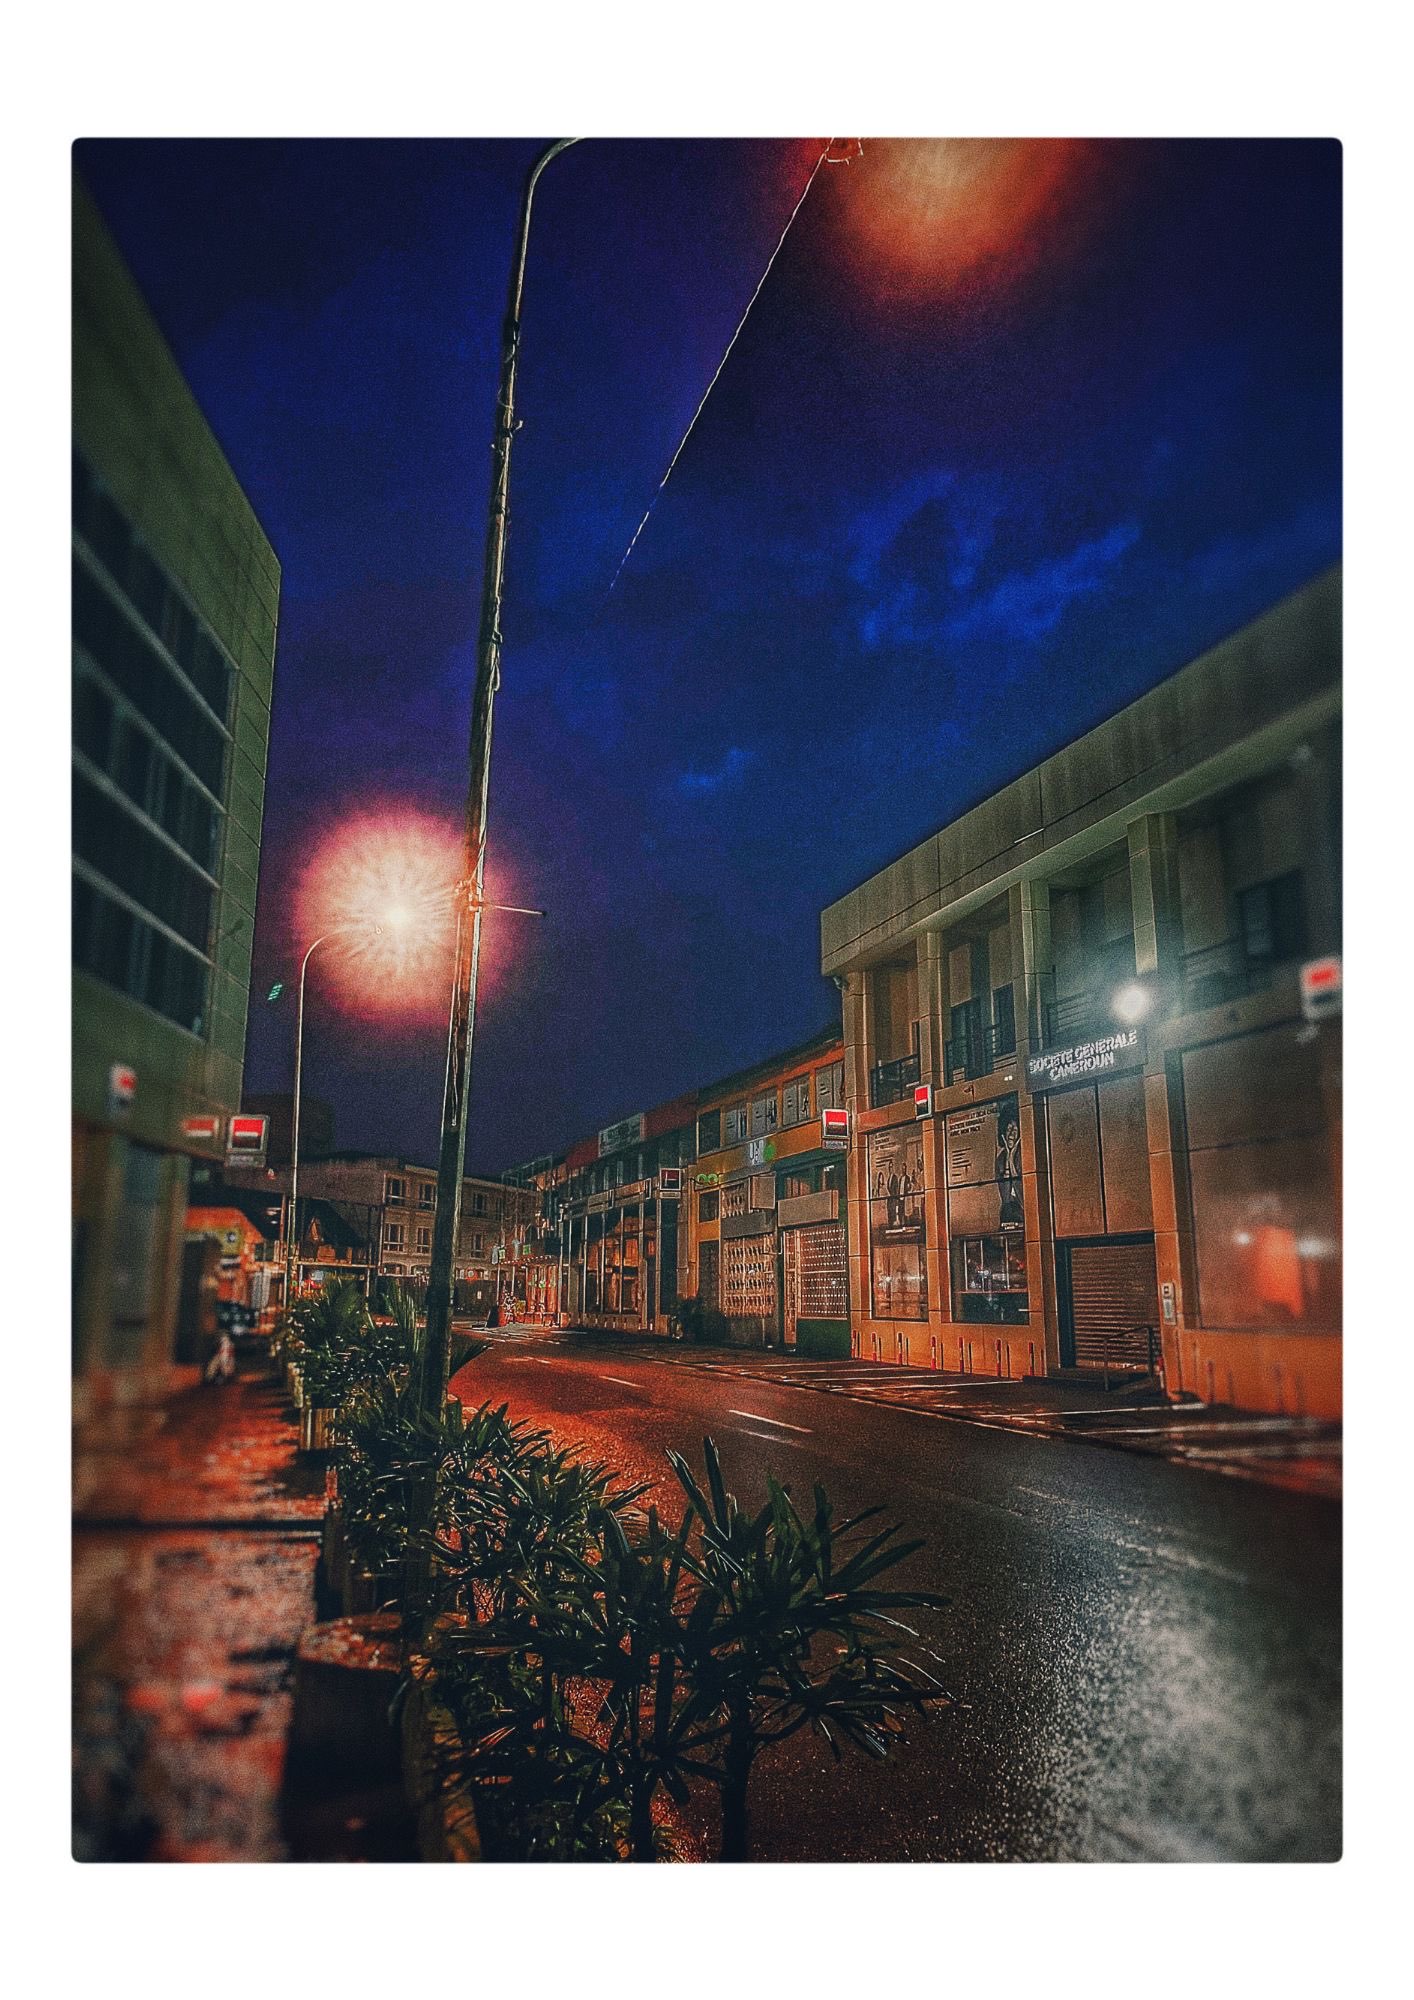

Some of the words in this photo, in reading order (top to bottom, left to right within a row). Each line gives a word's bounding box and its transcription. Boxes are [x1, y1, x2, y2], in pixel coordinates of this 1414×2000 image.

[1029, 1048, 1073, 1074] SOCIETE
[1074, 1029, 1138, 1060] GENERALE
[1049, 1051, 1115, 1081] CAMEROUN
